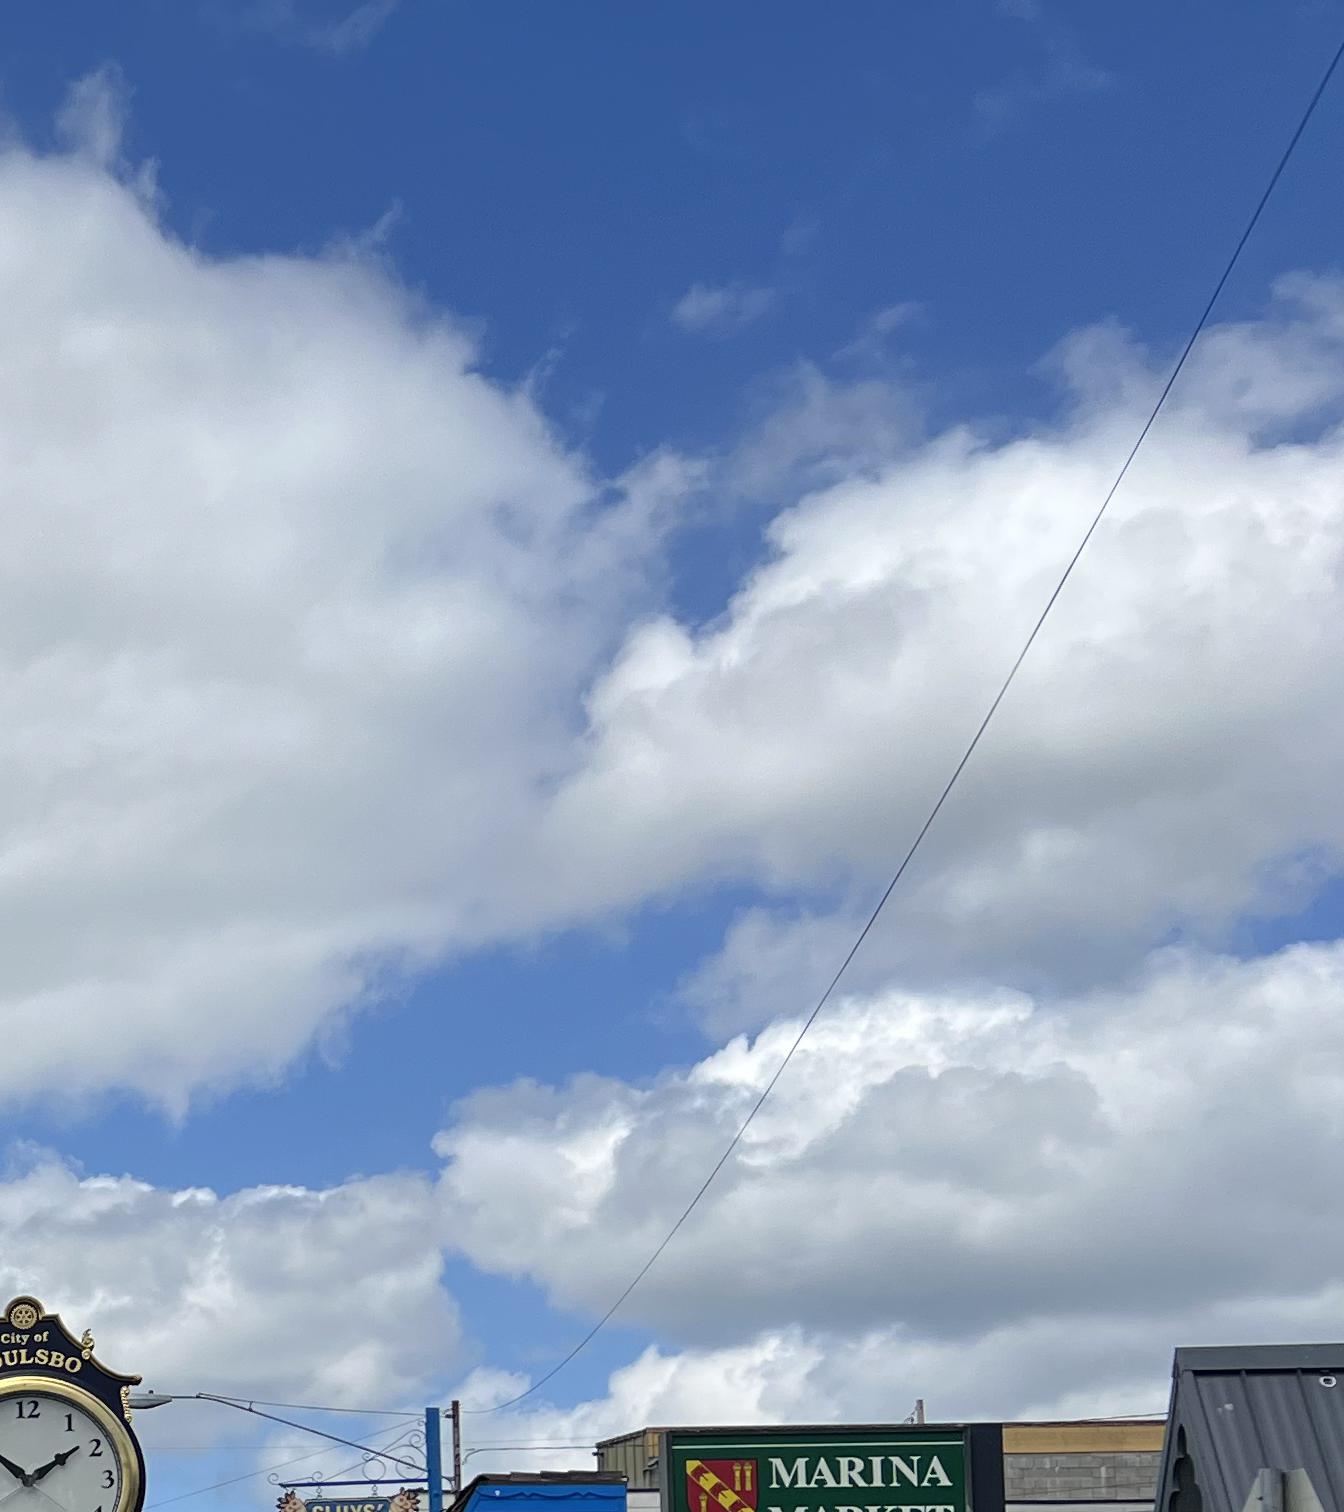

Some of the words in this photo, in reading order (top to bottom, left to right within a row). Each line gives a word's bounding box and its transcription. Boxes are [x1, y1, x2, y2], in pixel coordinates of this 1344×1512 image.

[0, 1332, 30, 1345] City
[34, 1331, 50, 1342] of
[16, 1401, 41, 1419] 12
[65, 1414, 75, 1432] 1
[89, 1439, 103, 1457] 2
[101, 1470, 114, 1489] 3
[768, 1455, 953, 1488] MARINA
